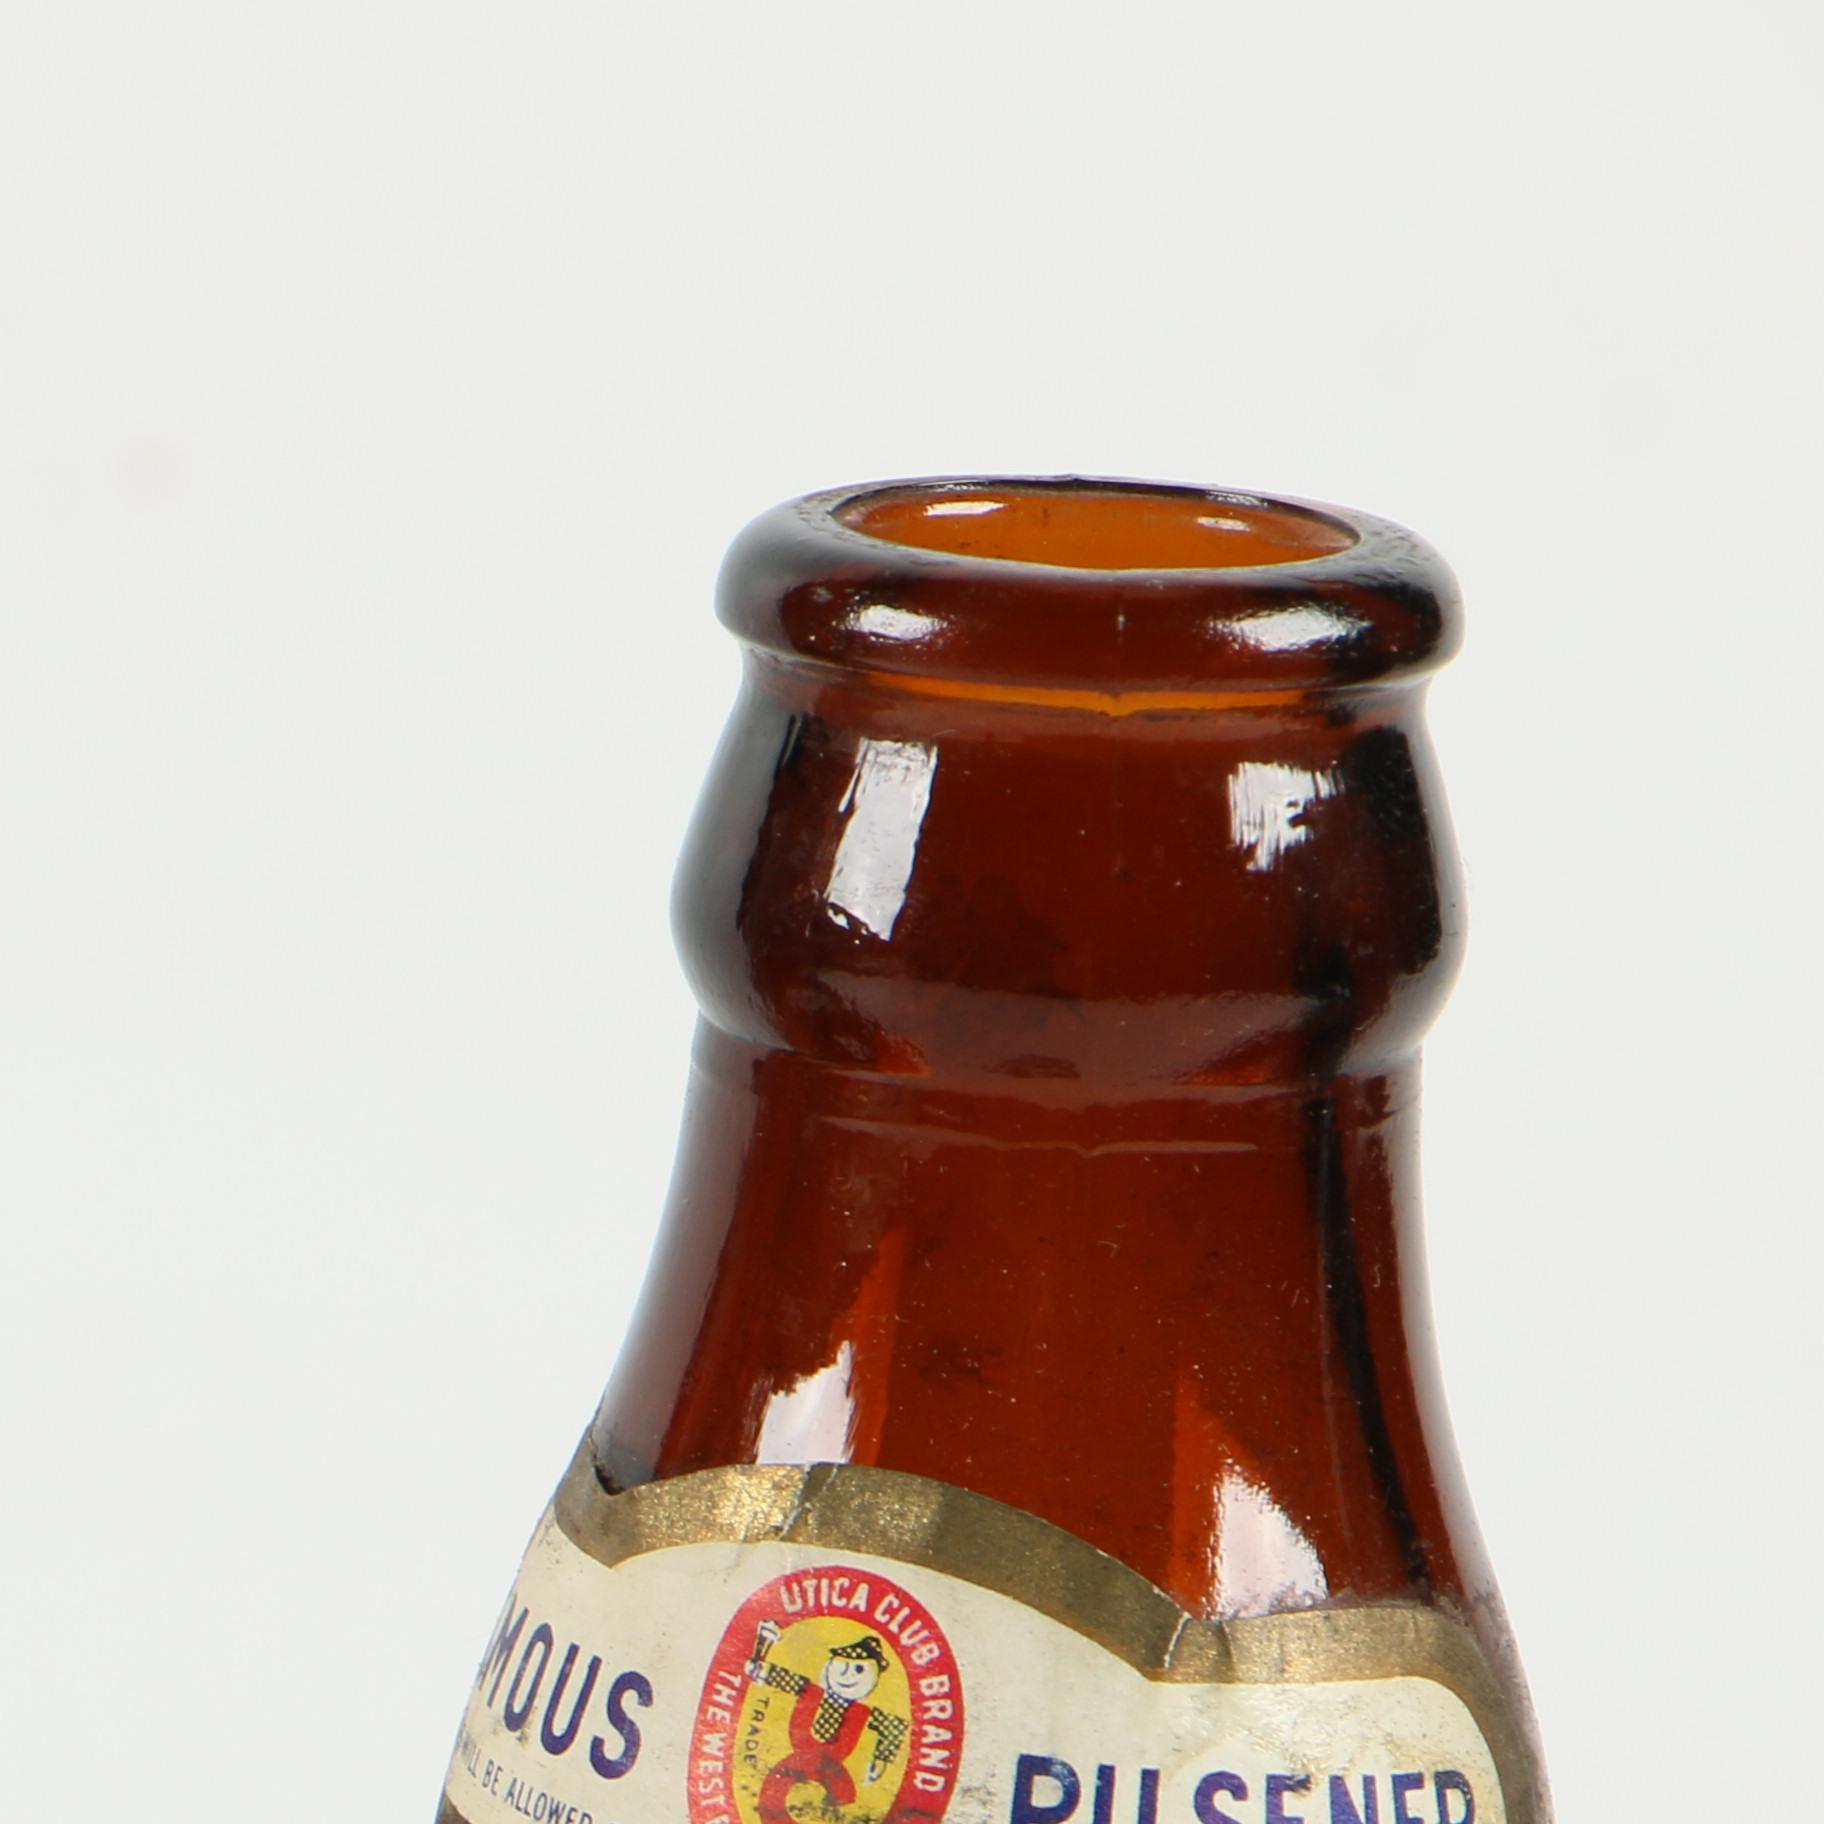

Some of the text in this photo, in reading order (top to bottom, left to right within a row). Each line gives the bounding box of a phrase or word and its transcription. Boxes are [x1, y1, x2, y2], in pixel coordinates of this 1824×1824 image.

[478, 1592, 654, 1780] MOUS
[706, 1670, 742, 1724] THE
[780, 1577, 952, 1793] UTICA CLUB BRAND
[743, 1696, 769, 1764] TRADE
[482, 1759, 503, 1796] BE
[698, 1732, 727, 1806] WEST
